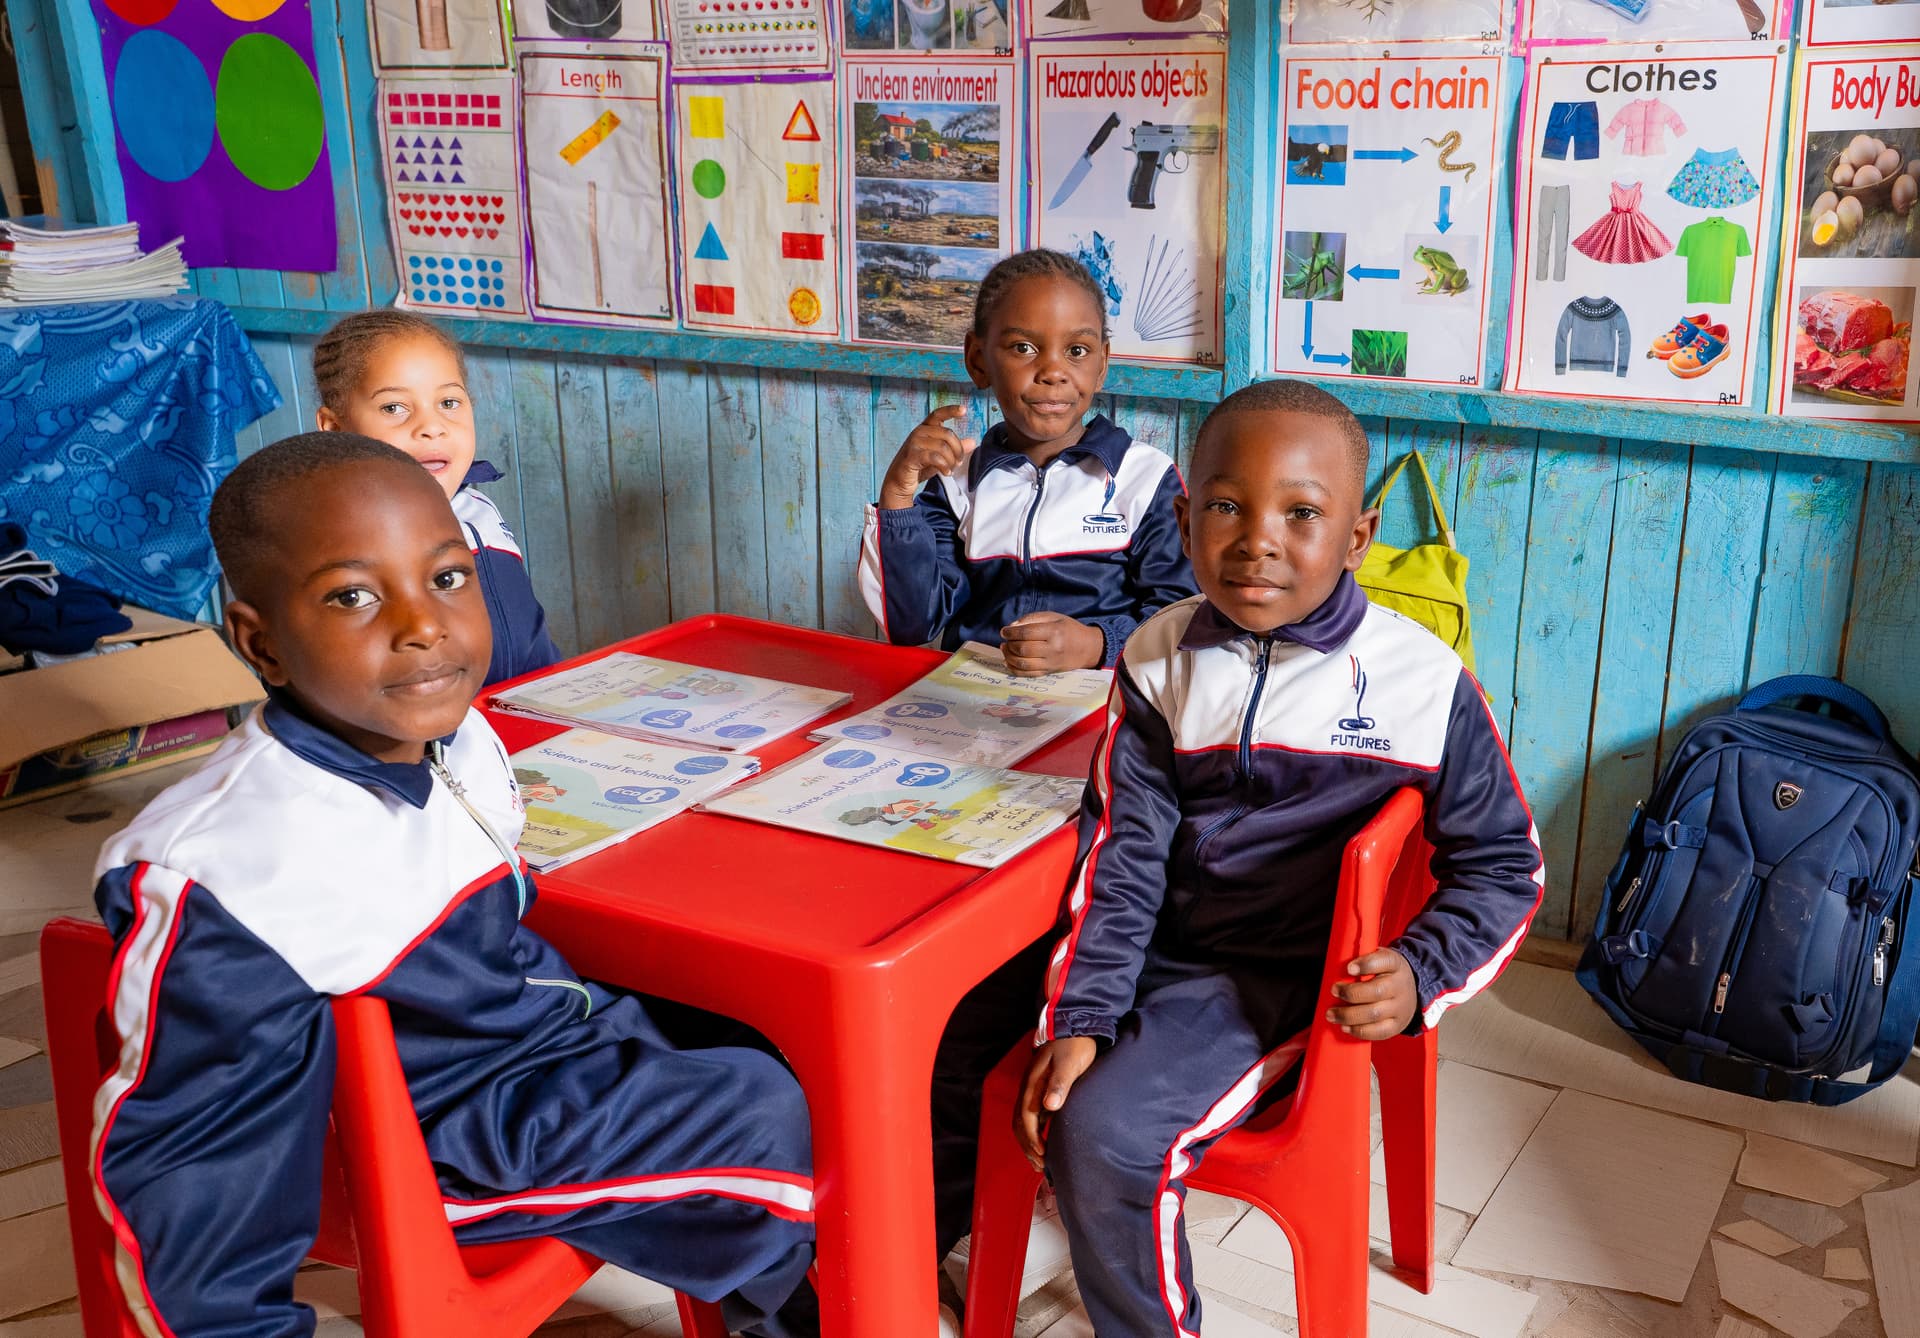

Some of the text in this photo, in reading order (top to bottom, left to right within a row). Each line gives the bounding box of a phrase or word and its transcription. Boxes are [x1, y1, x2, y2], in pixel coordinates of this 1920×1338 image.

[561, 68, 622, 93] Length
[856, 67, 998, 102] Unclean environment
[1046, 59, 1209, 107] Hazardous objects
[1297, 65, 1489, 110] Food chain
[1586, 63, 1718, 93] Clothes
[1831, 65, 1892, 120] Body
[1082, 525, 1127, 534] FUTURES
[687, 709, 746, 735] Technology
[1330, 734, 1391, 751] FUTURES
[538, 747, 697, 786] Science and Technology
[611, 787, 642, 797] ECD
[777, 795, 824, 815] Science
[823, 784, 846, 798] and
[841, 758, 901, 787] Technology
[591, 801, 643, 814] Workbook
